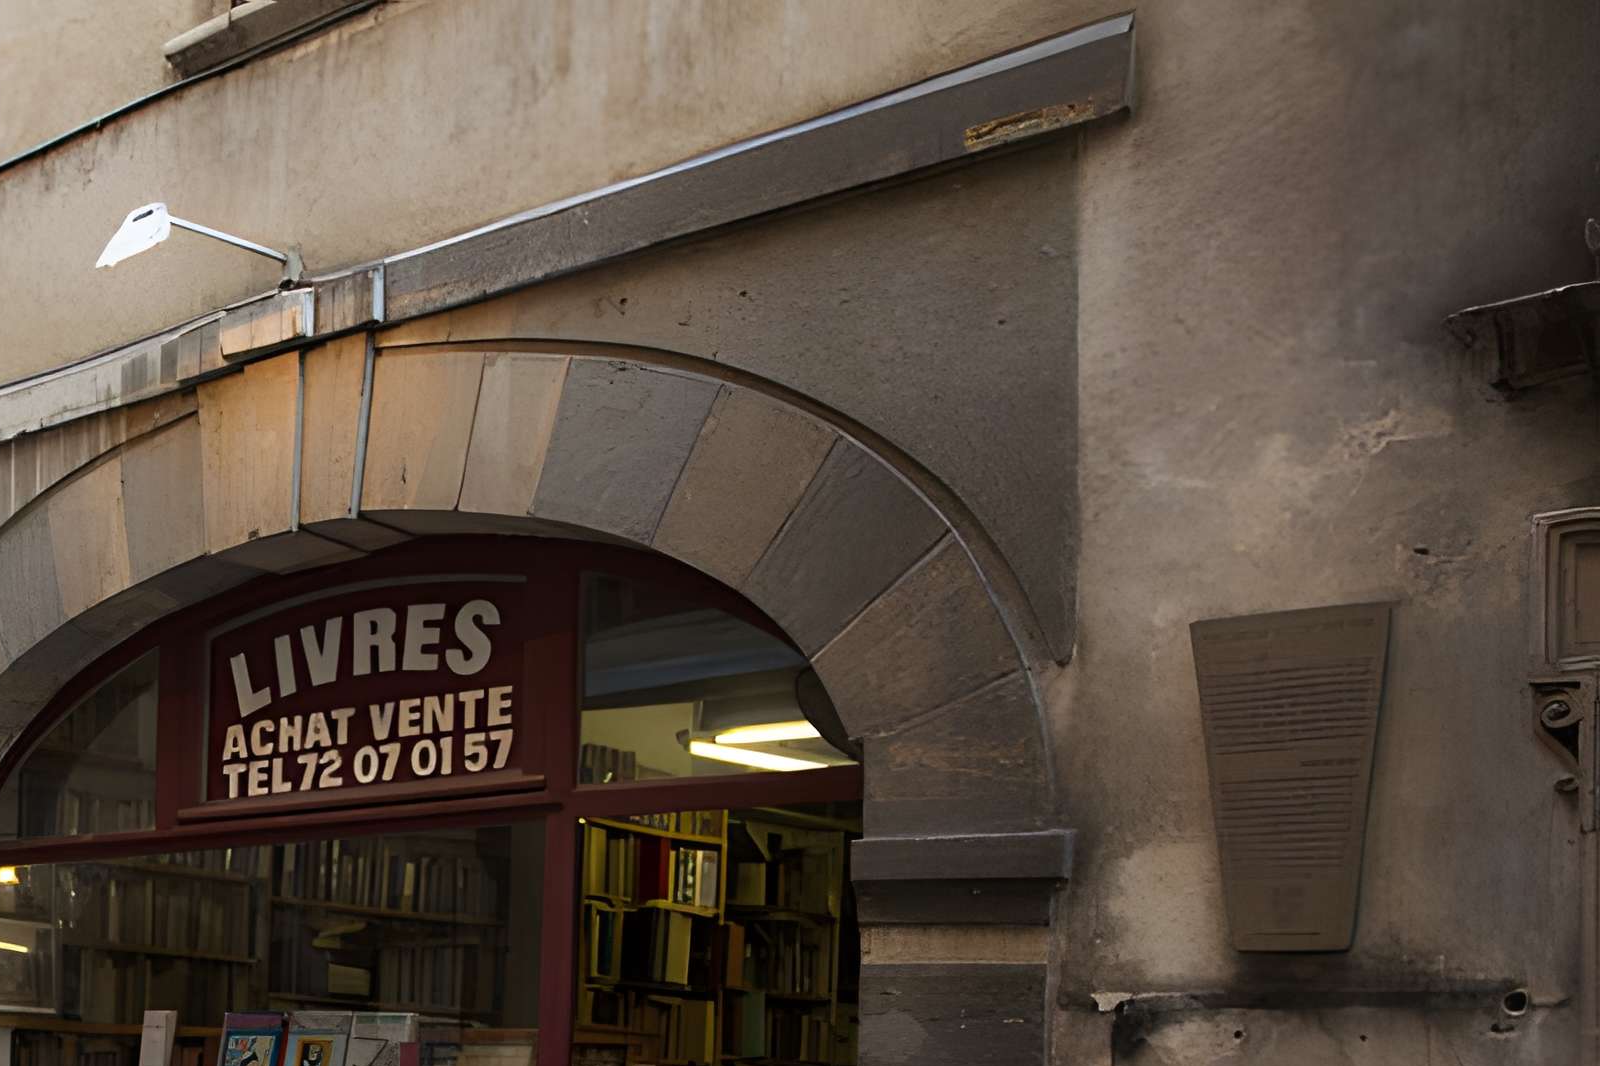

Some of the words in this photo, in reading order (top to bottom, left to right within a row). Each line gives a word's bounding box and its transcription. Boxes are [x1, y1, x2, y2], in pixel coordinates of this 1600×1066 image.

[230, 599, 501, 718] LIVRES
[222, 707, 356, 761] ACHAT
[368, 685, 514, 741] VENTE
[222, 757, 292, 799] TEL
[297, 750, 344, 791] 72
[353, 743, 401, 784] 07
[410, 736, 453, 776] 01
[464, 728, 514, 773] 57
